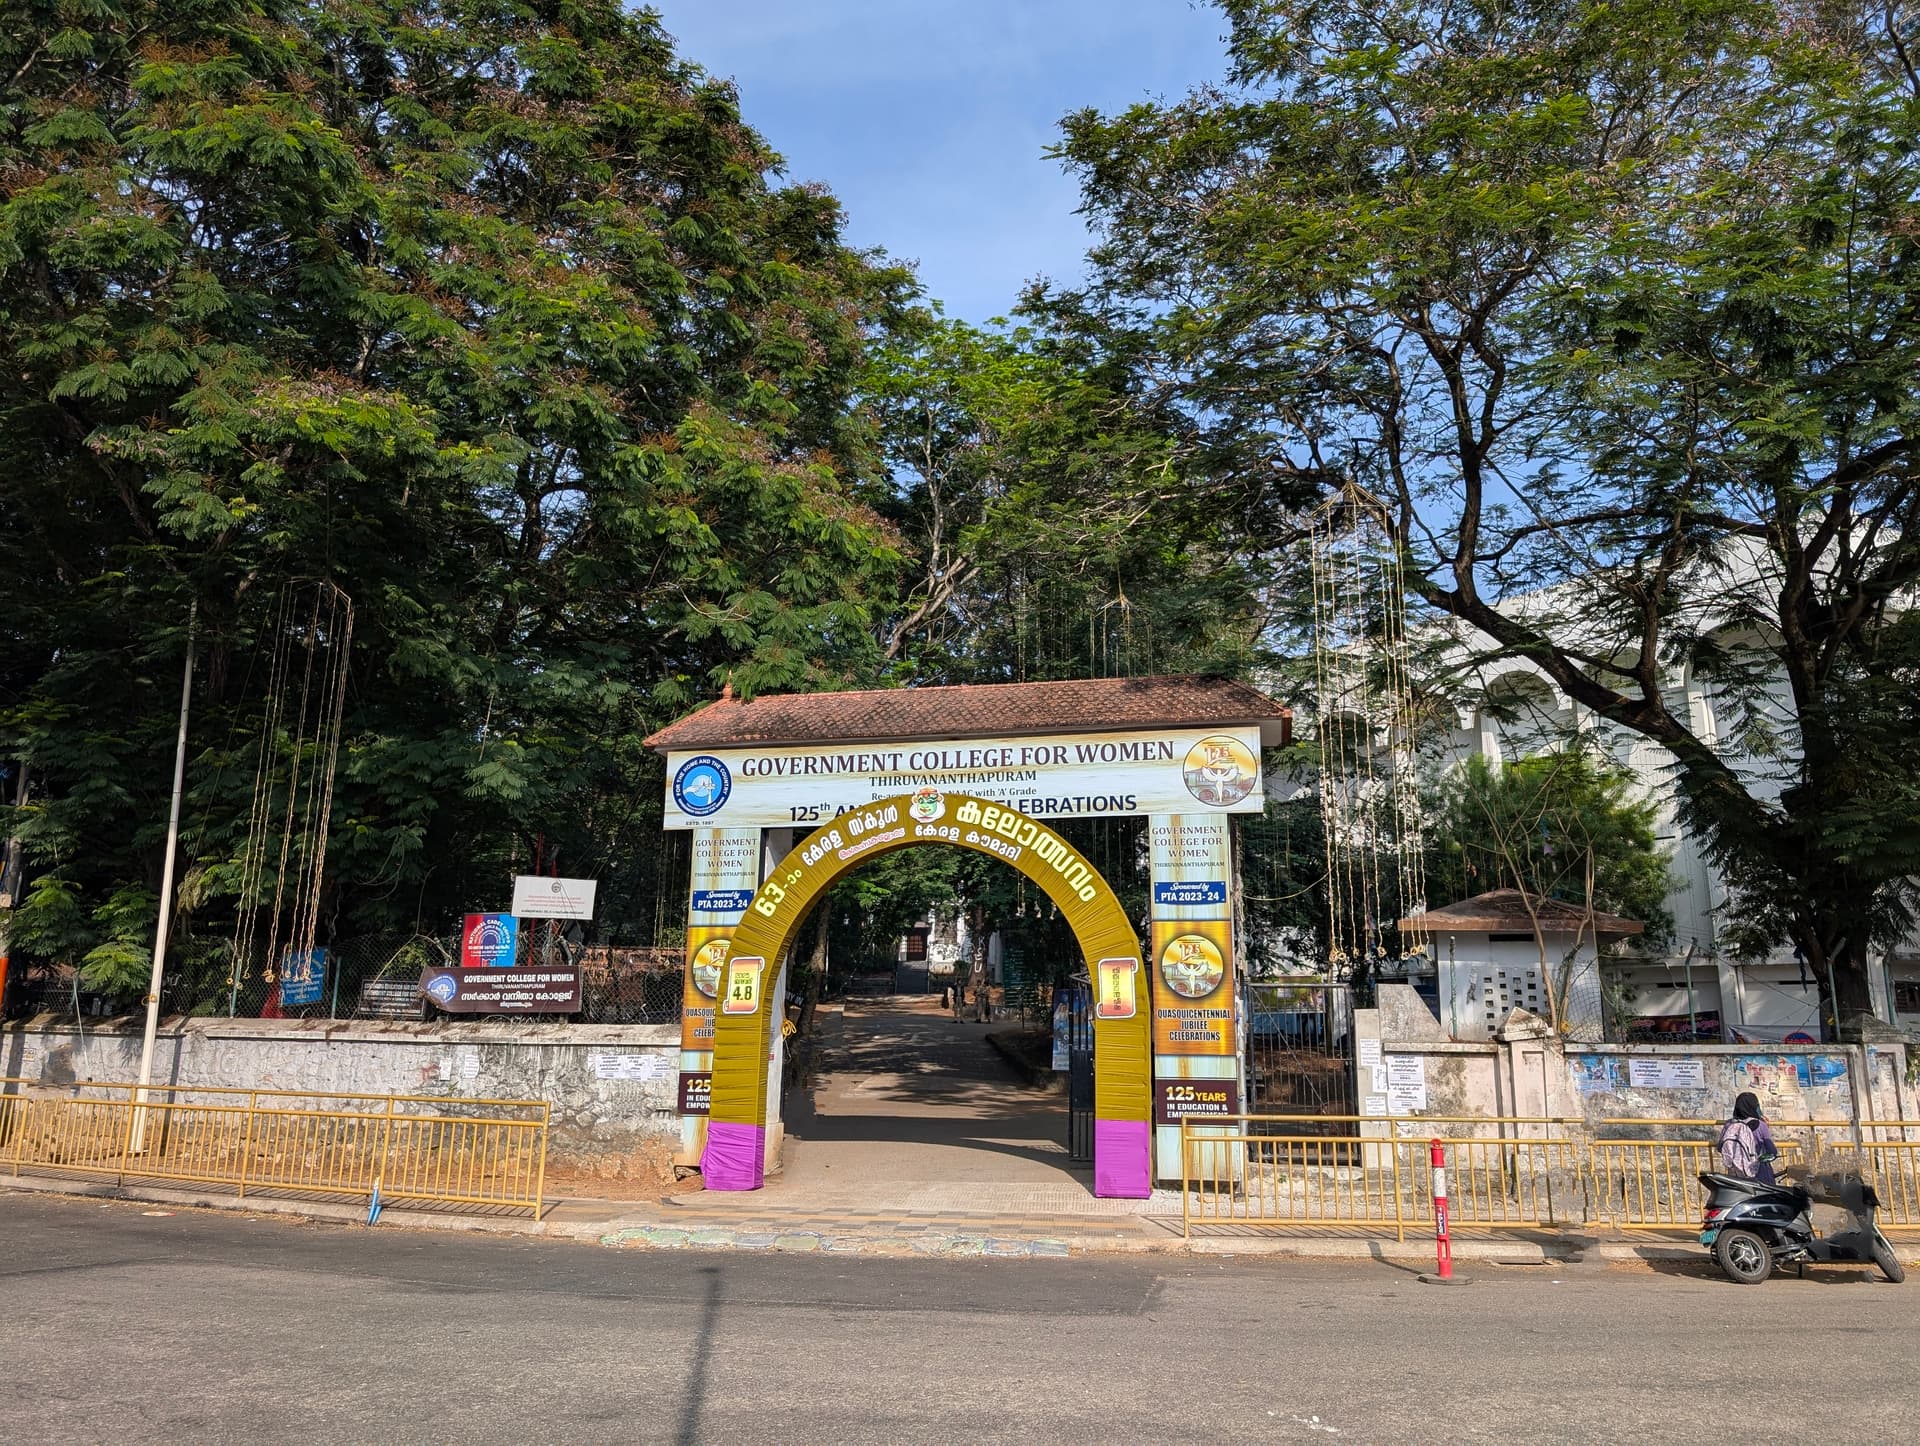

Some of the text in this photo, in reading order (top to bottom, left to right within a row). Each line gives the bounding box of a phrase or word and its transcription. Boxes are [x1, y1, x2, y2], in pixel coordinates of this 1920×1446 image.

[742, 741, 1174, 777] GOVERNMENT COLLEGE FOR WOMEN
[869, 770, 1037, 787] THIRUVANANTHAPURAM
[1009, 787, 1037, 796] Grade
[1152, 826, 1224, 835] GOVERNMENT
[695, 838, 758, 847] GOVERNMENT
[915, 825, 1022, 861] കേരള കൗമുദി
[1154, 837, 1223, 847] COLLEGE FOR
[696, 849, 735, 857] COLLEGE
[802, 830, 844, 866] കേരള
[849, 805, 898, 836] സ്കൂൾ
[956, 801, 1097, 902] കലോത്സവം
[1168, 849, 1209, 858] WOMEN
[707, 860, 742, 868] WOMEN
[1161, 892, 1177, 901] PTA
[697, 900, 712, 909] PTA
[469, 921, 487, 944] NATIONAL
[463, 973, 575, 983] GOVERNMENT COLLEGE FOR WOMEN
[502, 990, 533, 1001] വനിതാ
[1157, 1009, 1231, 1019] QUASQUICENTENNIAL
[1181, 1021, 1208, 1030] JUBILEE
[1169, 1031, 1221, 1041] CELEBRATIONS
[686, 1079, 711, 1092] 125
[1166, 1086, 1227, 1101] 125 YEARS
